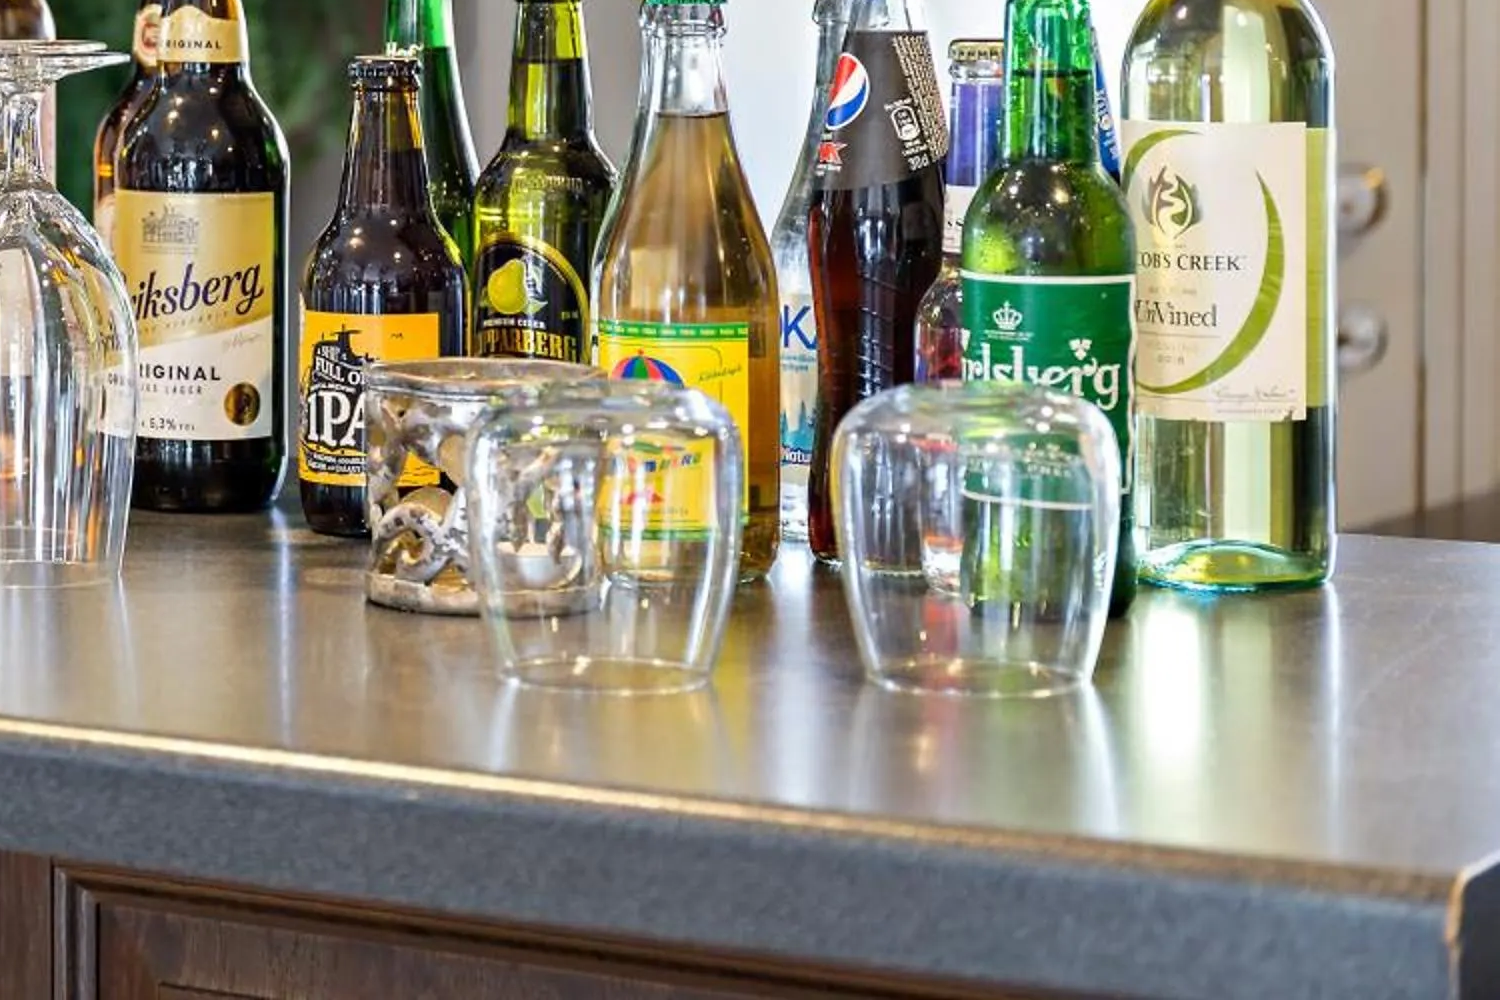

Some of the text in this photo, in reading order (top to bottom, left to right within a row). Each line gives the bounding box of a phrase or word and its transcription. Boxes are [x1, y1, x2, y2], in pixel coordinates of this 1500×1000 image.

[1177, 254, 1241, 271] CREEK
[120, 262, 265, 320] iksberg
[480, 328, 577, 363] PPARBERG
[139, 362, 221, 382] IGINAL
[315, 356, 345, 382] FULL
[307, 389, 367, 447] IPA
